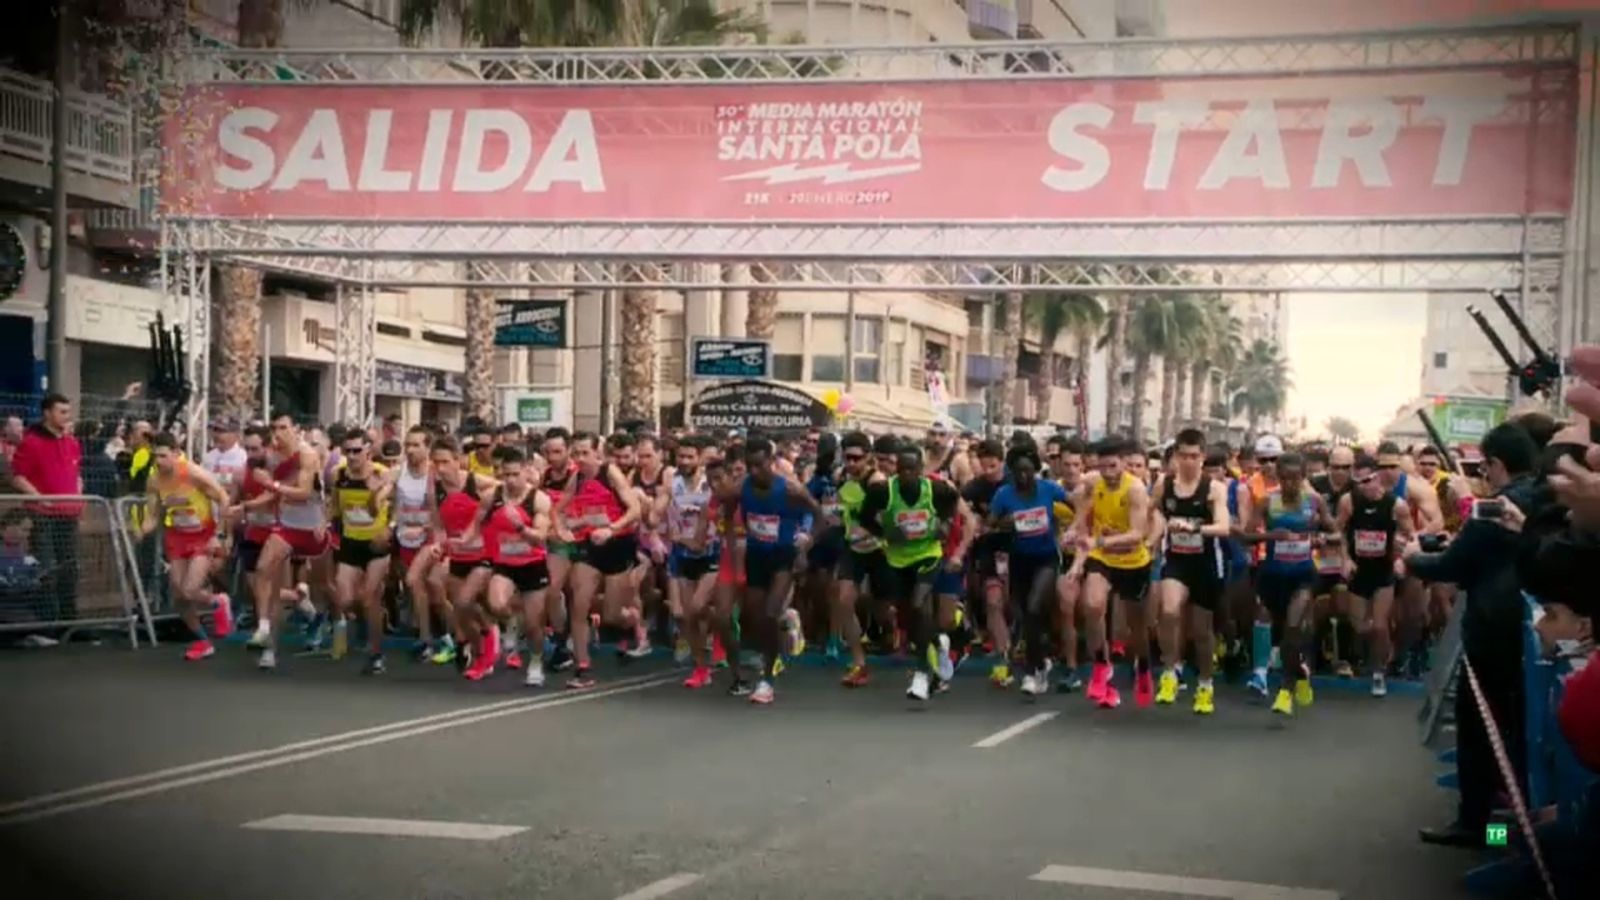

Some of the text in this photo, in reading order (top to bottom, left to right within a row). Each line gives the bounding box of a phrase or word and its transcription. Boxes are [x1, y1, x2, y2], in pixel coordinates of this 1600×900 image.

[748, 102, 814, 118] MEDIA
[818, 98, 923, 118] MARATÓN
[717, 119, 923, 134] INTERNACIONAL
[213, 106, 607, 193] SALIDA
[718, 135, 922, 160] SANTA POLA
[1041, 95, 1507, 192] START
